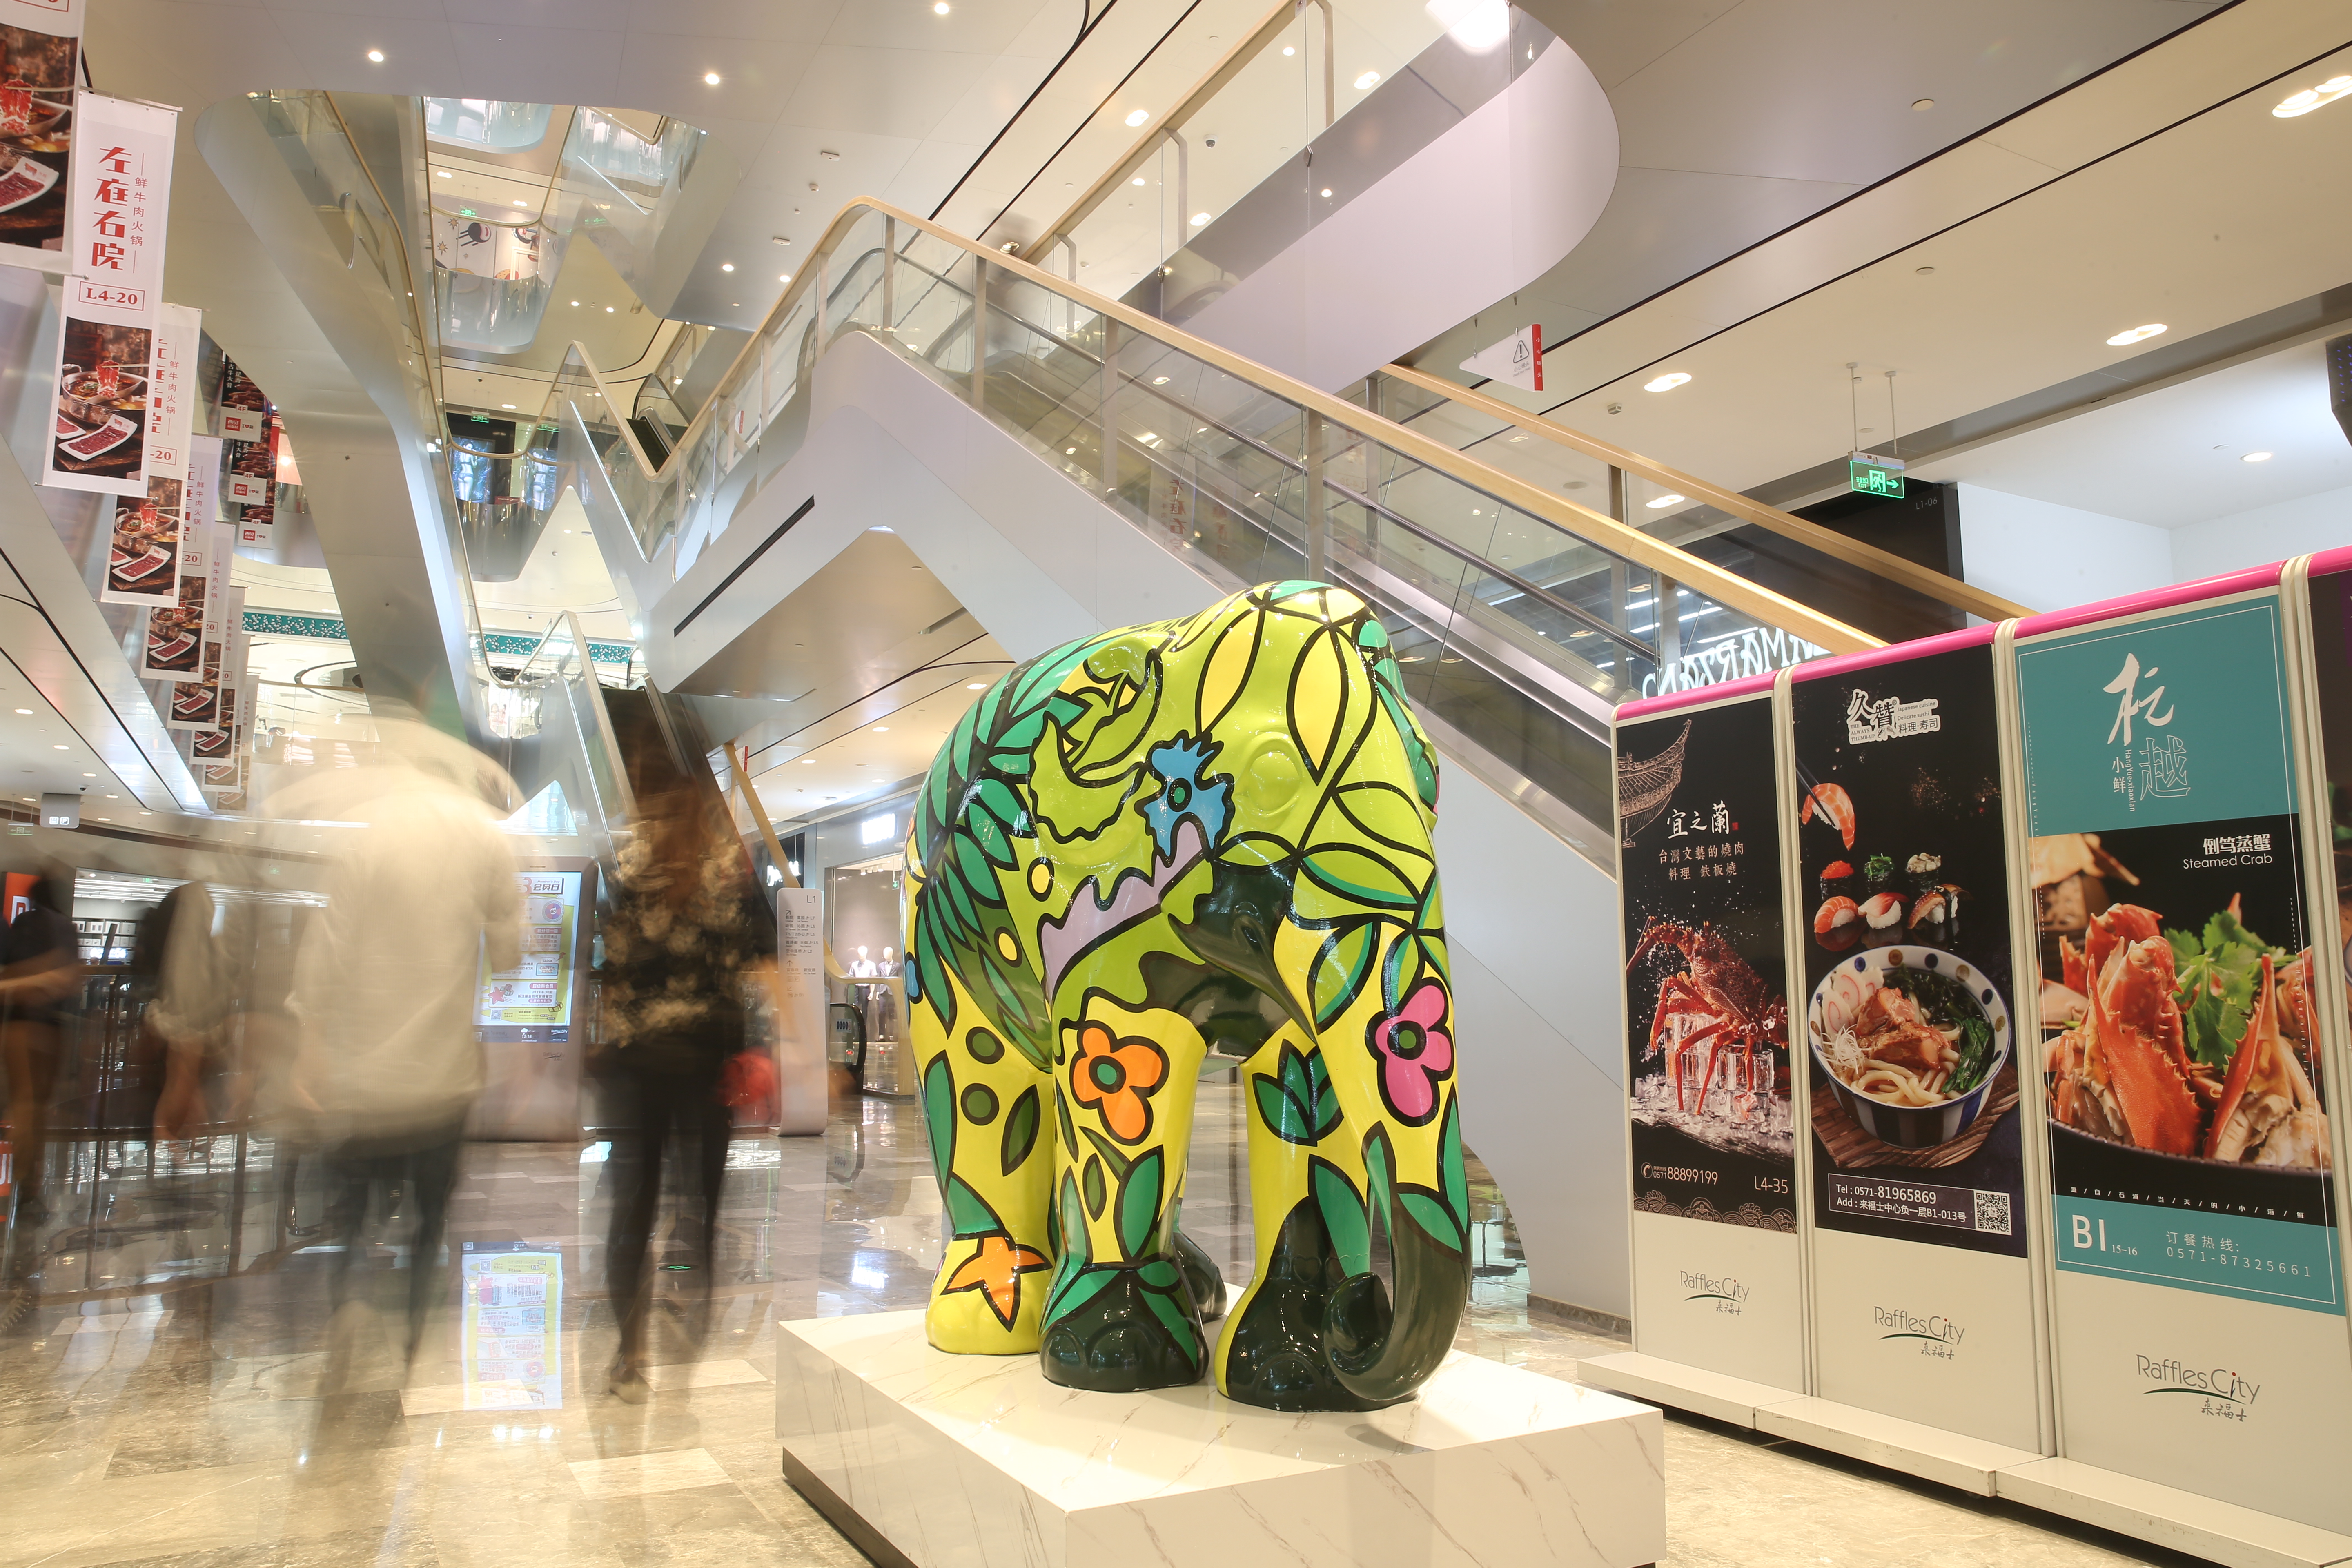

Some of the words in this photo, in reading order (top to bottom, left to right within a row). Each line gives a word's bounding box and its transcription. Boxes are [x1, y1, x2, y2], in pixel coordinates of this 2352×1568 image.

[91, 147, 132, 271] 左庭右院
[130, 177, 148, 247] 鲜牛肉火锅
[86, 287, 138, 305] L4-20
[166, 360, 179, 414] 鲜牛肉火锅
[150, 450, 172, 461] -20
[193, 481, 205, 526] 鲜牛肉火锅
[1916, 497, 1938, 510] L1-06
[211, 561, 220, 599] 鲜牛肉火锅
[1851, 734, 1875, 742] THUMB-UP
[2112, 757, 2126, 793] 小鲜
[2183, 855, 2238, 870] Steamed
[2241, 853, 2272, 865] Crab
[1668, 866, 1691, 881] 料理
[806, 895, 816, 903] L1
[1653, 1171, 1666, 1179] 0571
[1667, 1167, 1718, 1185] 88899199
[1754, 1176, 1788, 1194] L4-35
[1854, 1185, 1937, 1205] 0571-81965869
[2167, 1247, 2311, 1278] 0571-87325661
